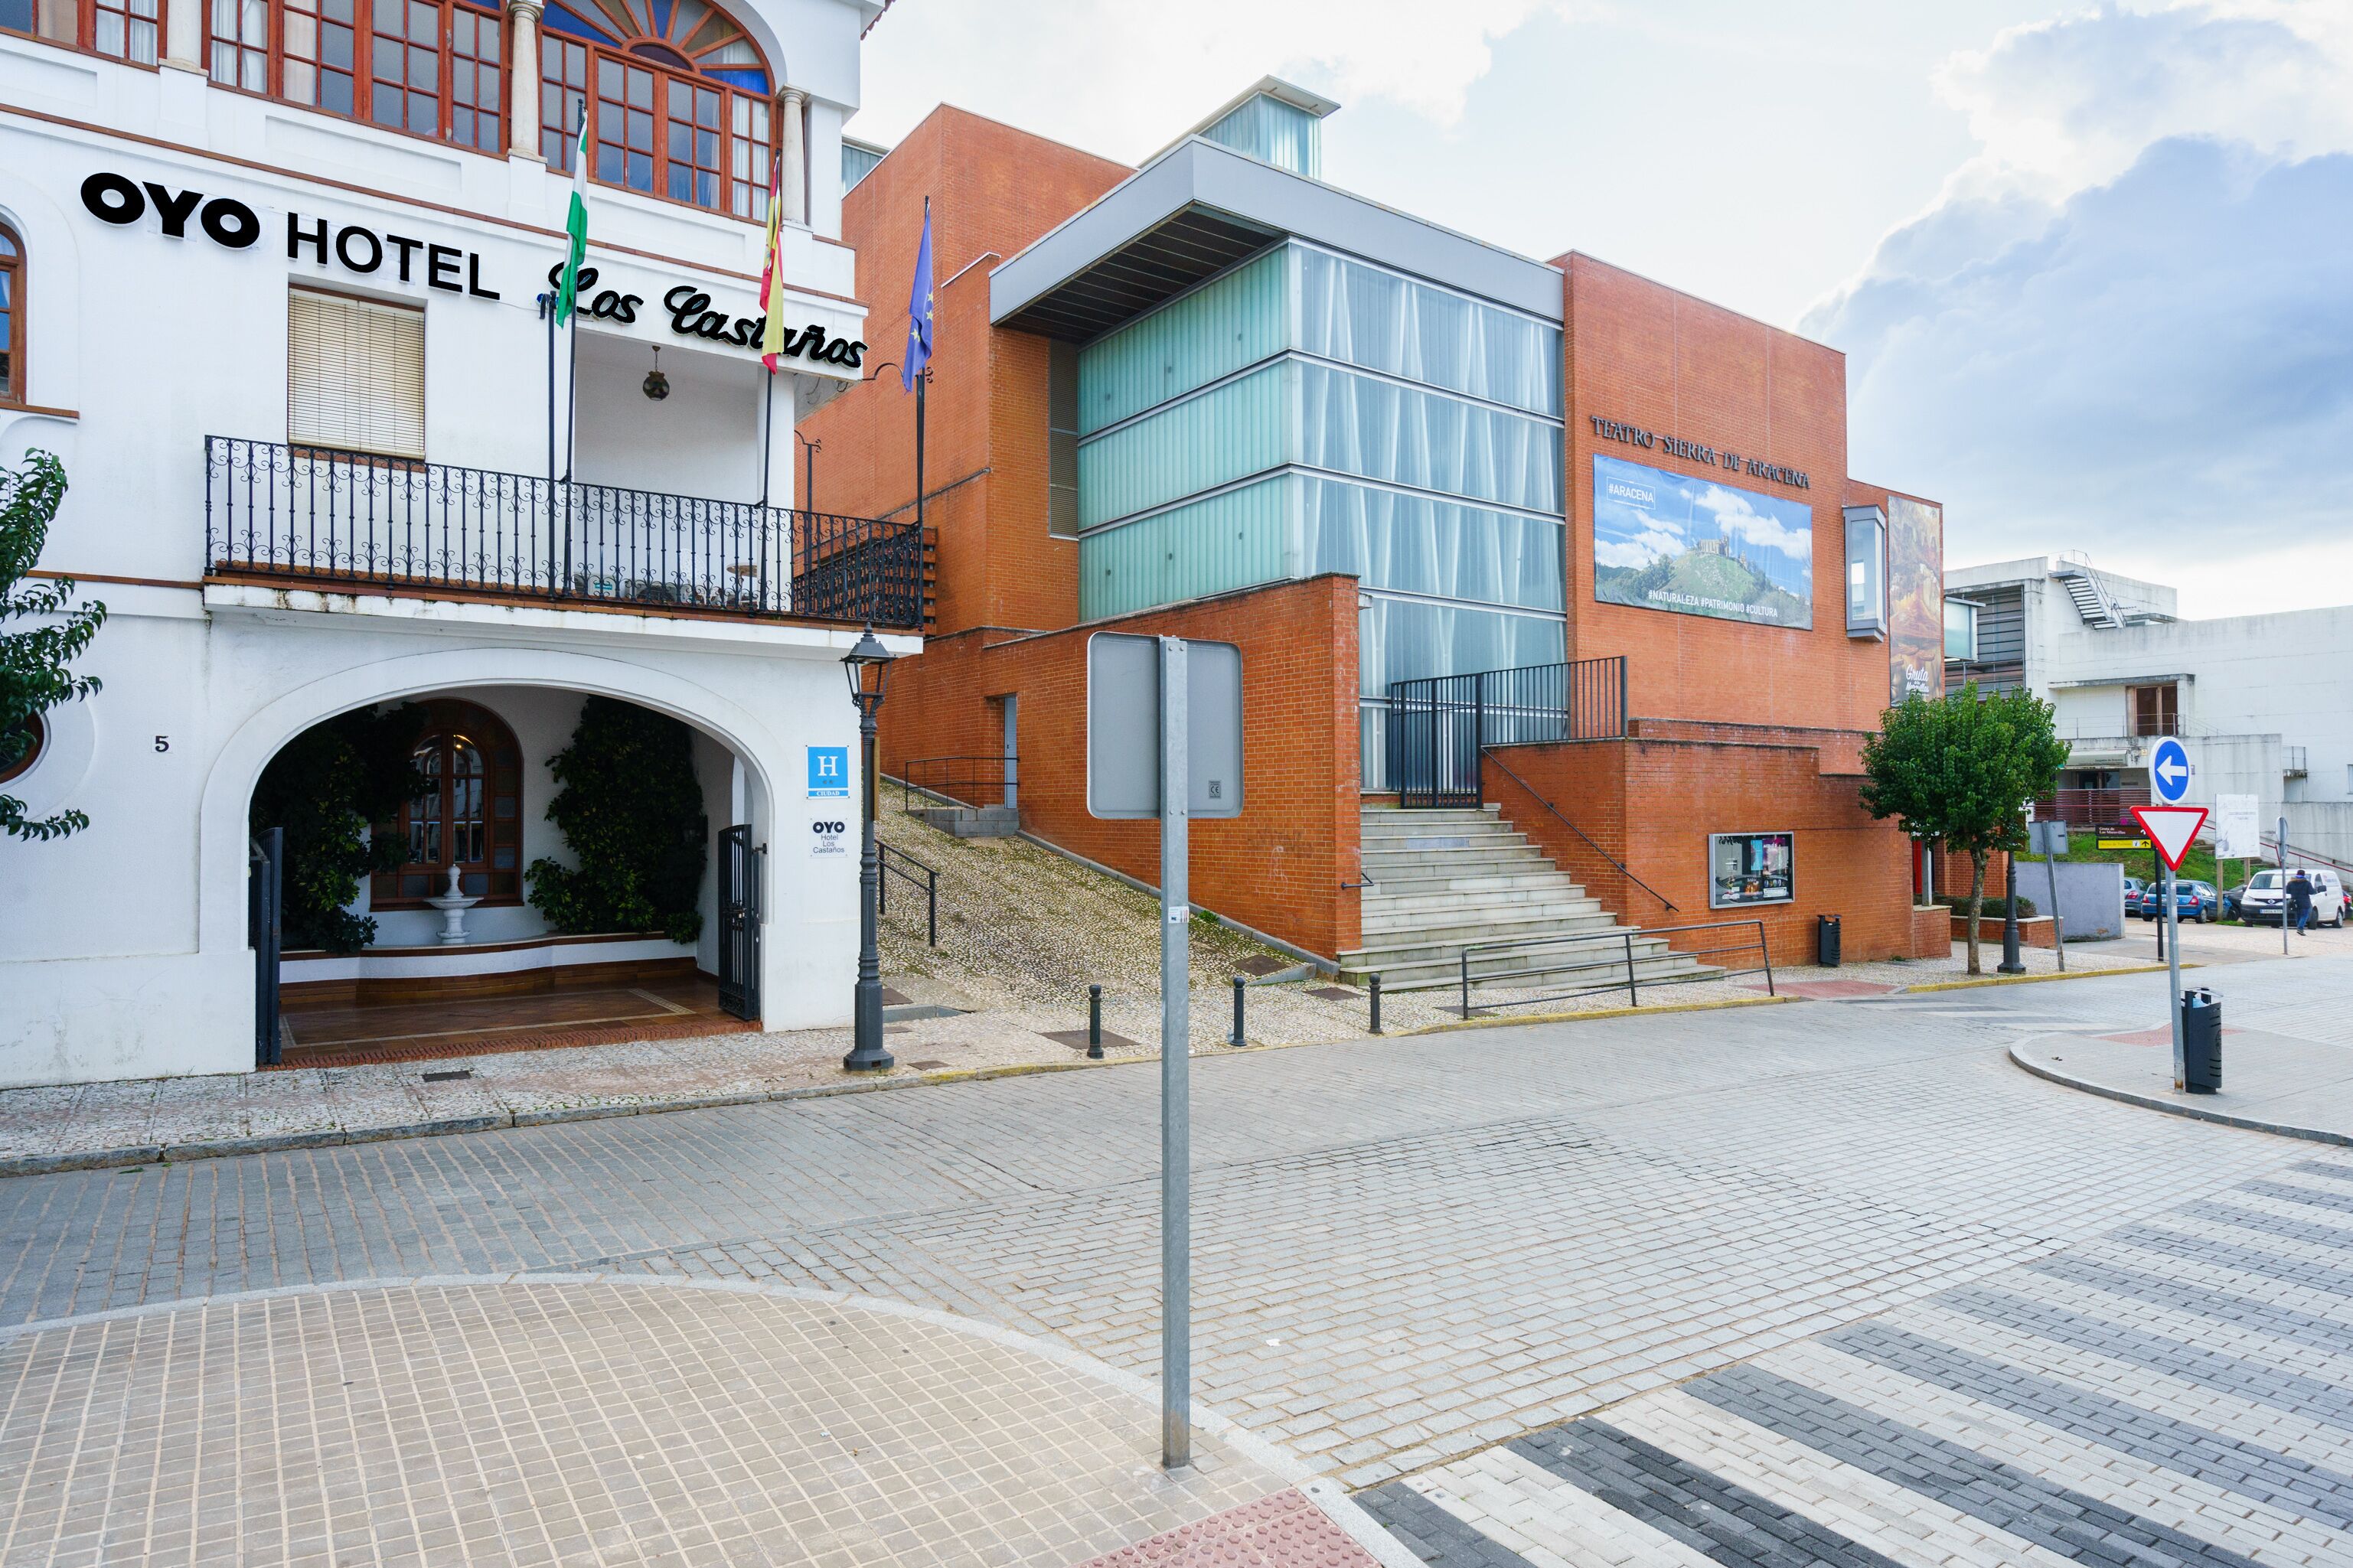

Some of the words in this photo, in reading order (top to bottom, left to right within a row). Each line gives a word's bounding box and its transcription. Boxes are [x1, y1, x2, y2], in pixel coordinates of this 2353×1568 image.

[80, 172, 259, 248] OYO
[288, 212, 500, 300] HOTEL
[548, 261, 644, 323] Los
[1589, 415, 1656, 448] TEATRO
[1663, 435, 1716, 465] SIERRA
[1722, 451, 1740, 471] DE
[1747, 458, 1811, 489] ARACENA
[1608, 483, 1654, 503] #ARACENA
[1648, 589, 1699, 606] #NATURALEZA
[1701, 598, 1744, 613] #PATRIMONIO
[1745, 604, 1778, 618] #CULTURA
[1906, 663, 1929, 682] Gruta
[155, 735, 169, 752] 5
[818, 755, 838, 776] H
[812, 821, 845, 834] OYO
